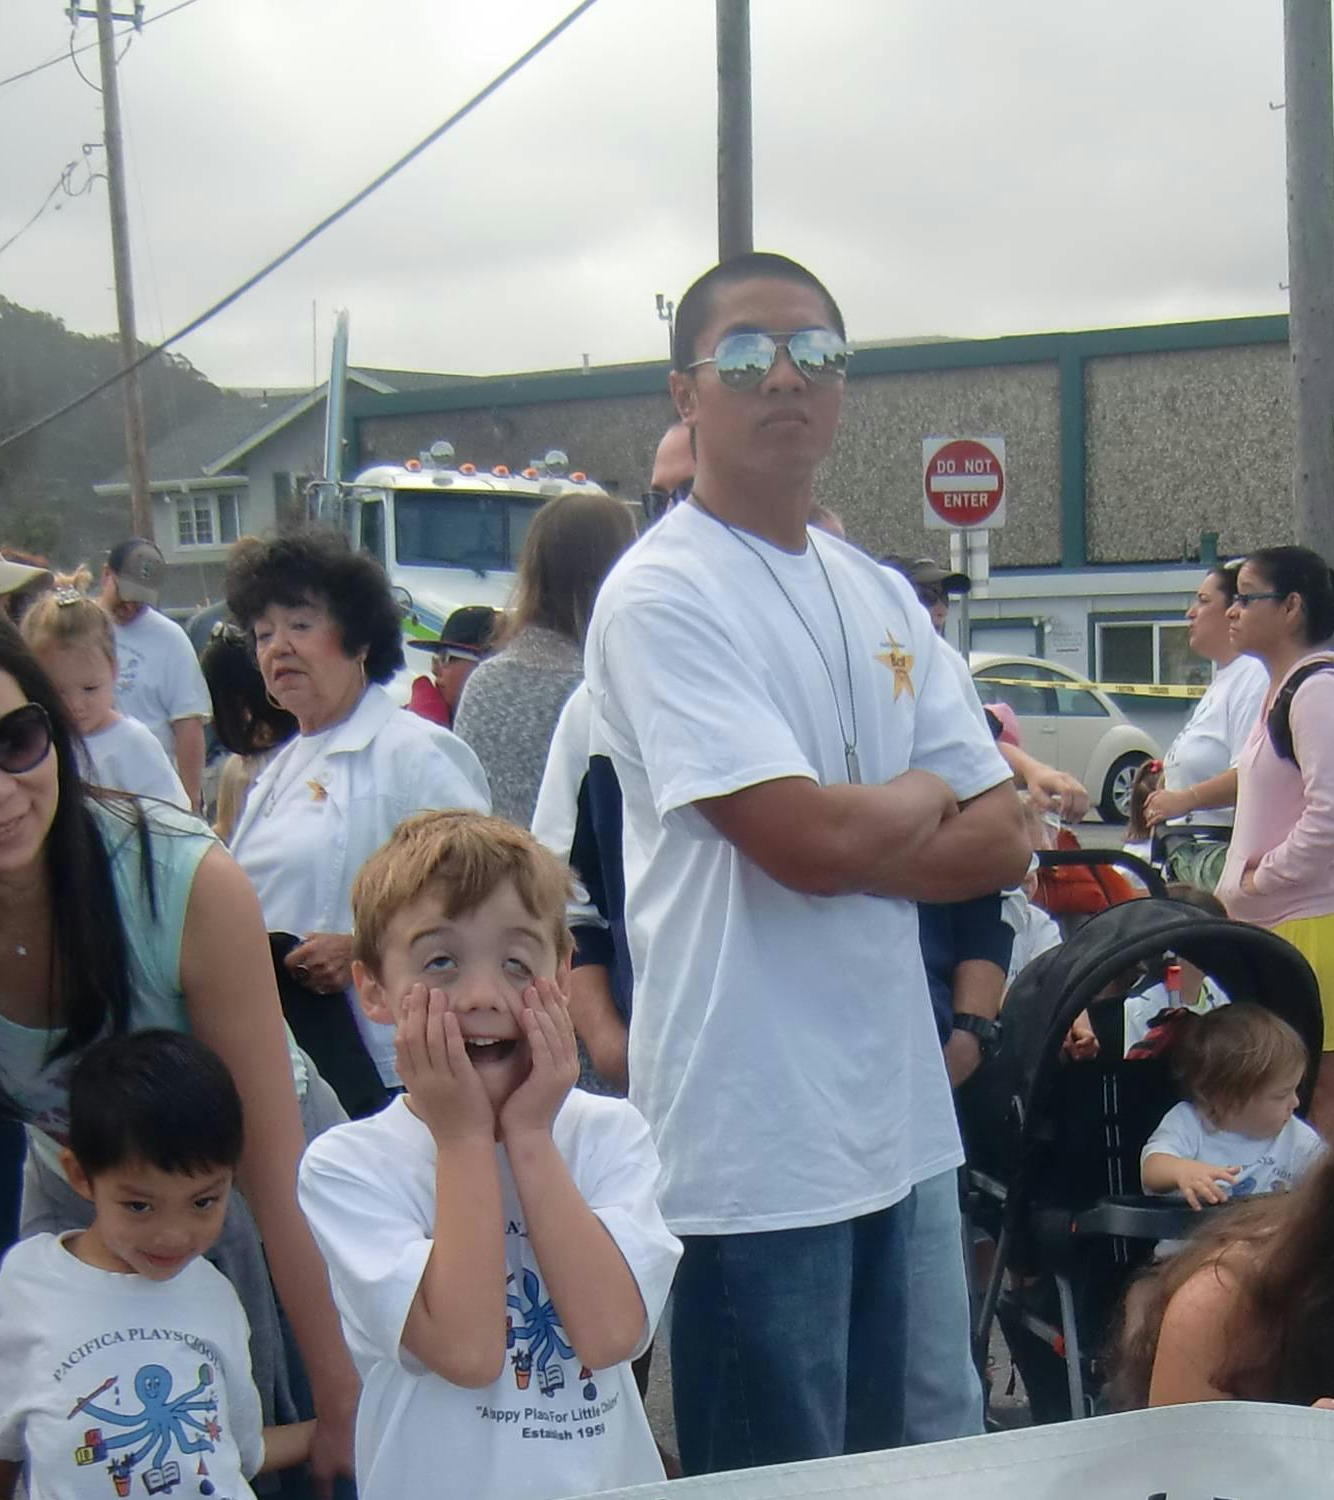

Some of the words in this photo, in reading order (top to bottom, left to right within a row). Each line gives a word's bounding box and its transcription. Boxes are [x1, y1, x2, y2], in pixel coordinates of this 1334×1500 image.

[937, 460, 956, 473] DO
[965, 459, 992, 473] NOT
[944, 493, 989, 508] ENTER
[53, 1331, 125, 1383] PACIFICA
